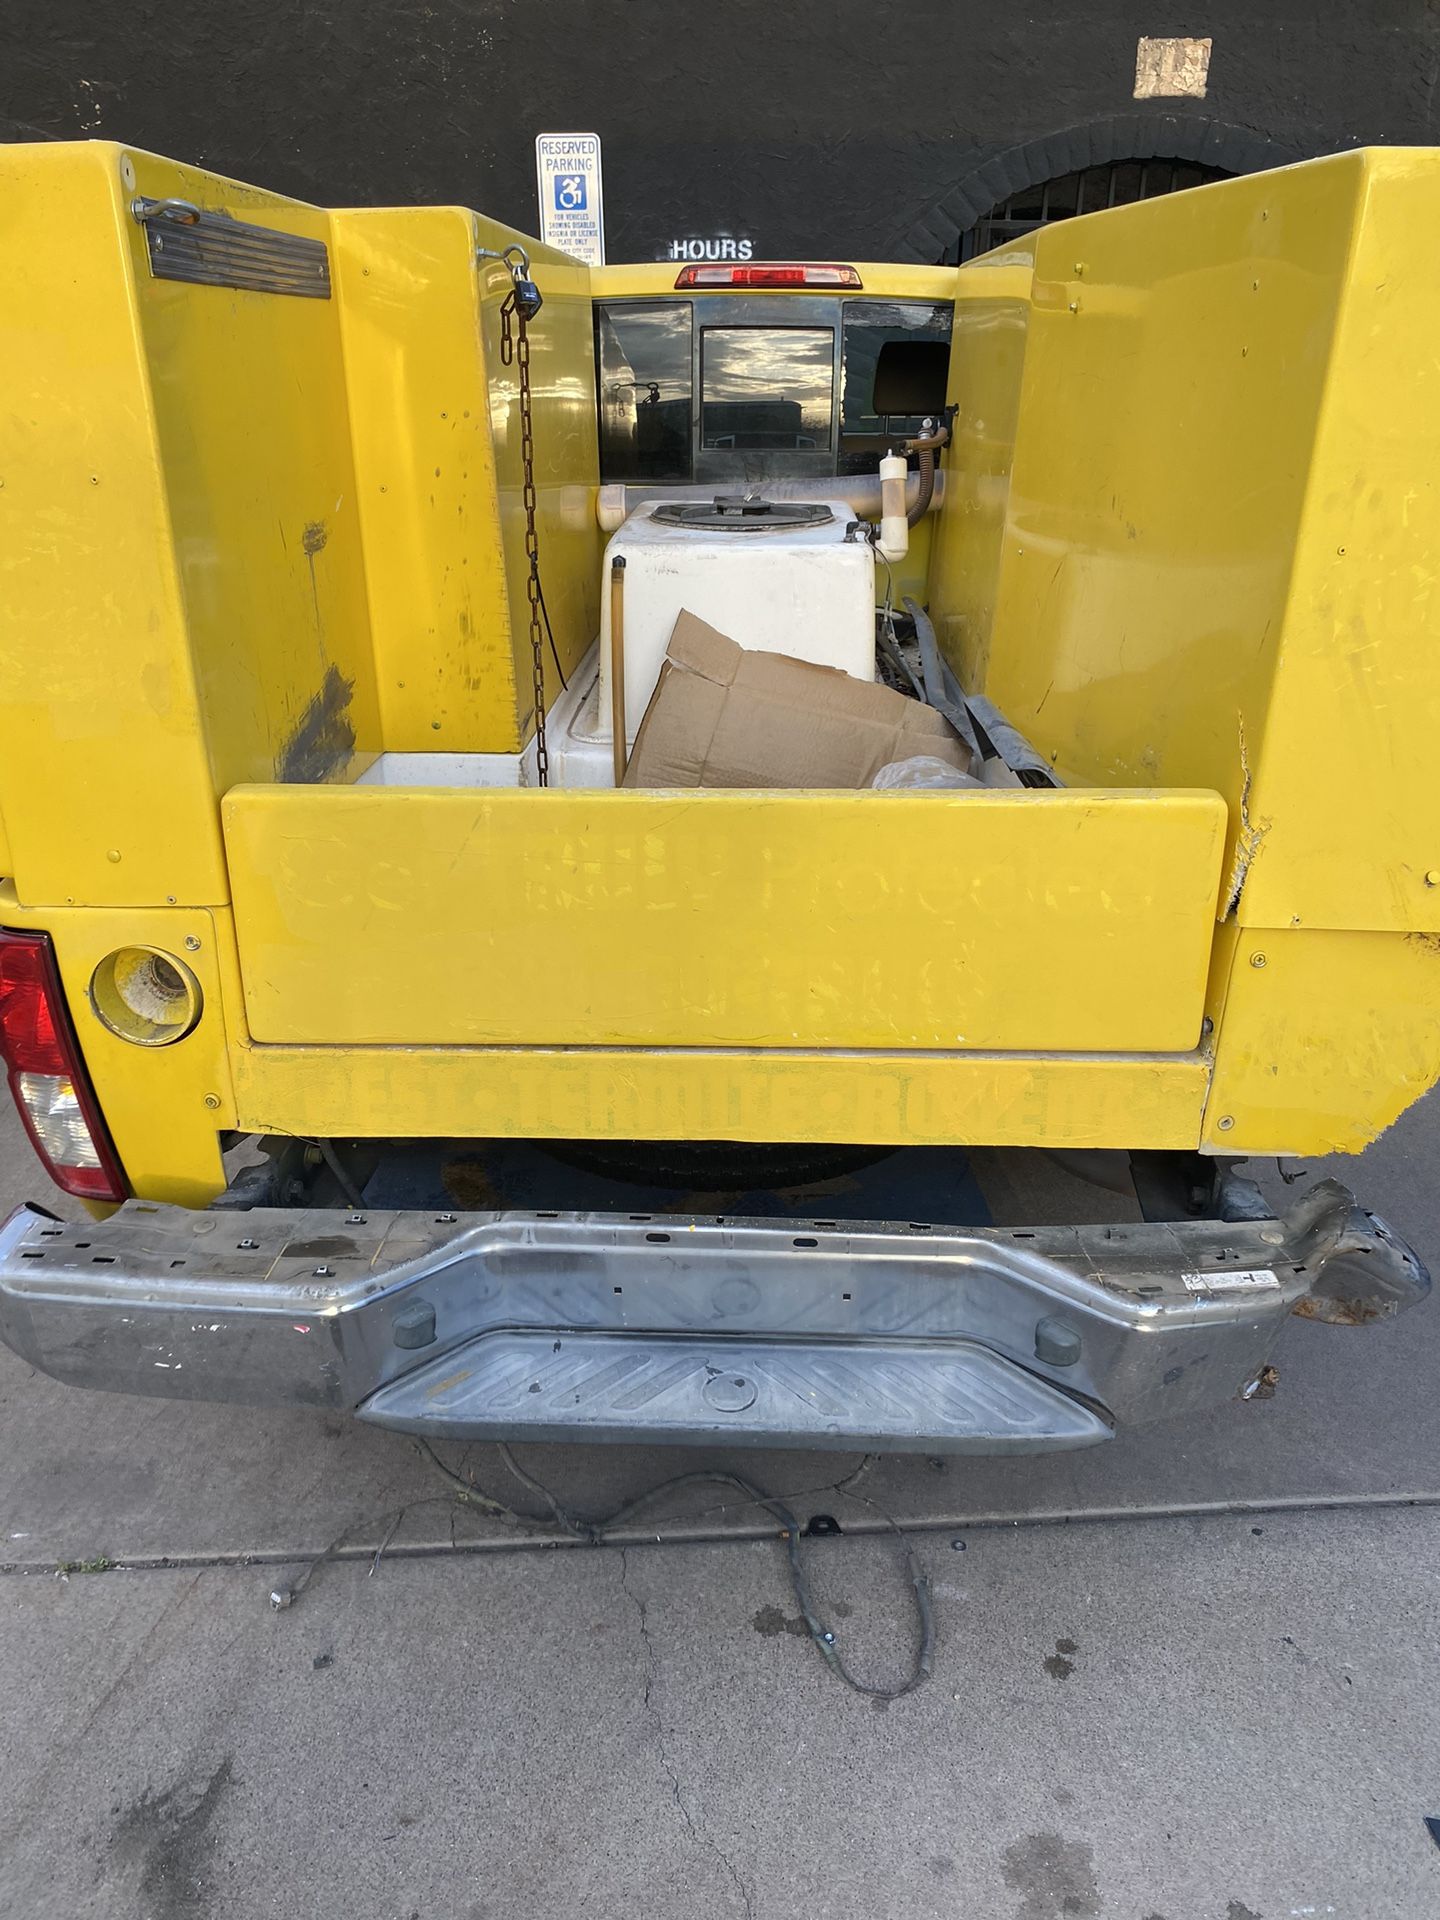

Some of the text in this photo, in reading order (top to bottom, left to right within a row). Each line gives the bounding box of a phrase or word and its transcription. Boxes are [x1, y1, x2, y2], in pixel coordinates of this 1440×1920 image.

[541, 141, 595, 154] RESERVED
[546, 158, 592, 171] PARKING
[672, 239, 753, 260] HOURS
